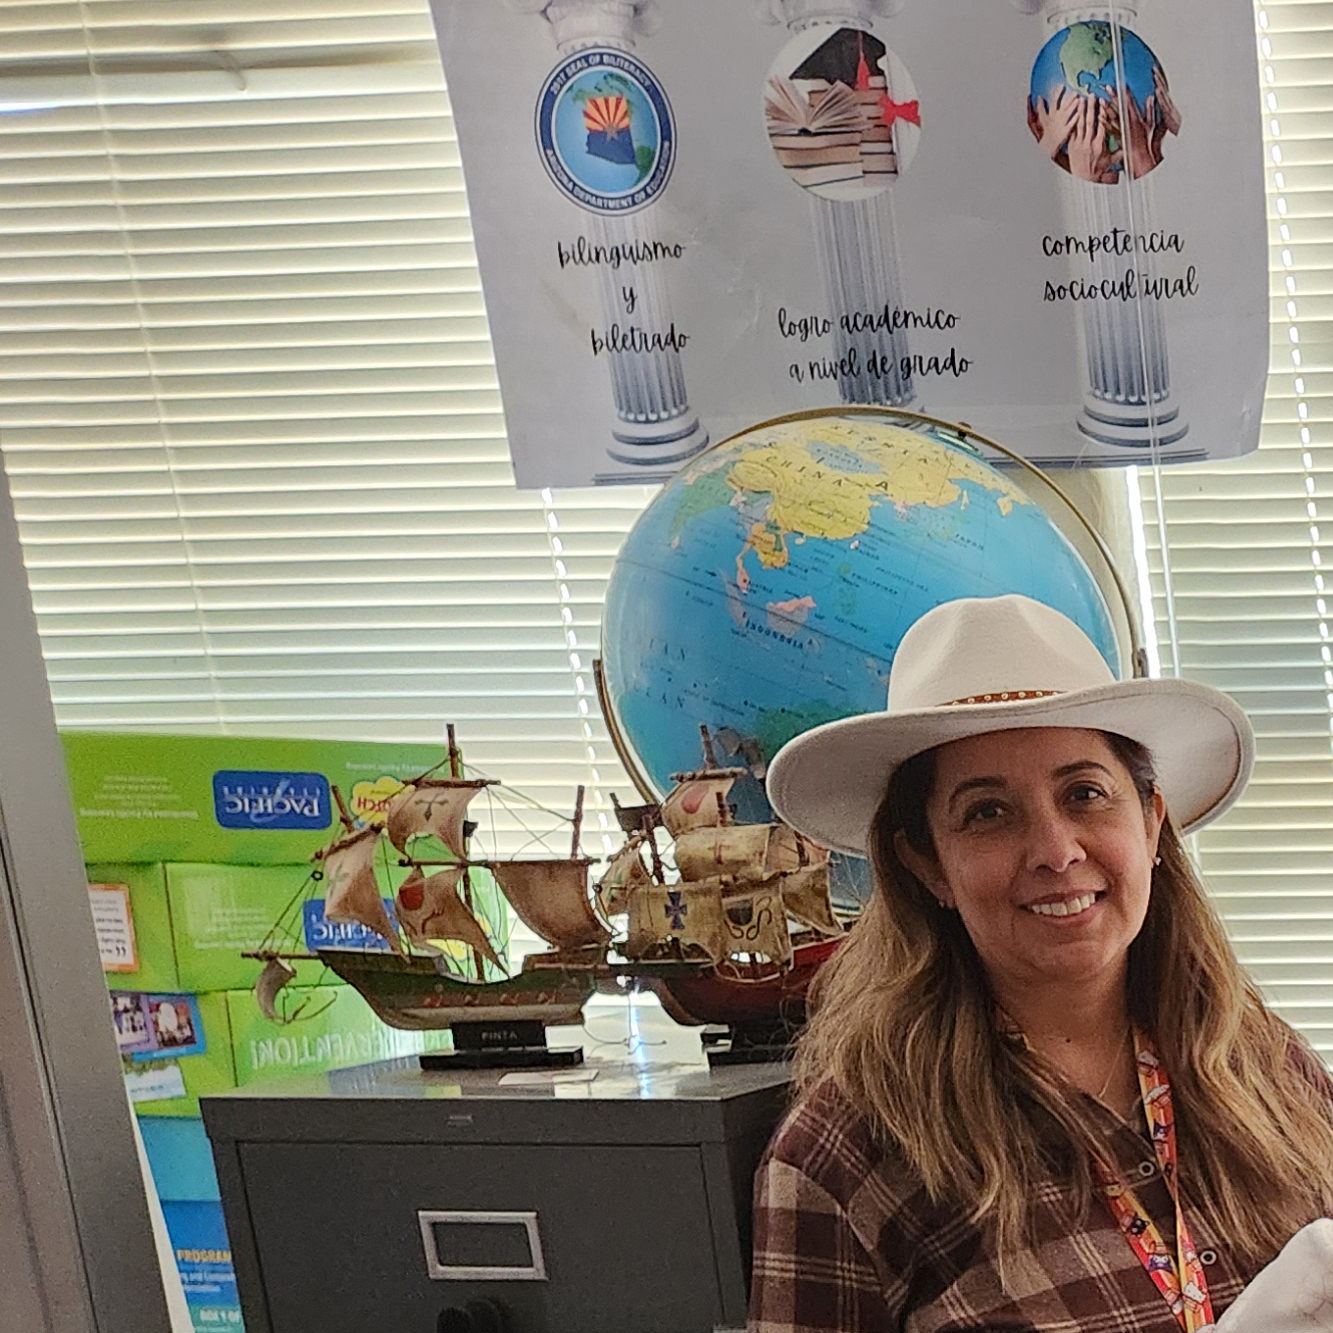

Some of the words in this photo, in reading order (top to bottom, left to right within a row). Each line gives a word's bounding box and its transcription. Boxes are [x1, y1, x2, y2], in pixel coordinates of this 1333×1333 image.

[557, 235, 686, 270] bilinguismo
[1042, 227, 1185, 263] competencia
[622, 286, 638, 314] y
[1043, 265, 1199, 302] sociocultural
[591, 322, 690, 356] biletrado
[778, 307, 834, 342] logro
[840, 303, 961, 335] académico
[789, 362, 805, 383] a
[809, 347, 861, 381] nivel
[867, 349, 893, 380] de
[900, 347, 974, 381] grado
